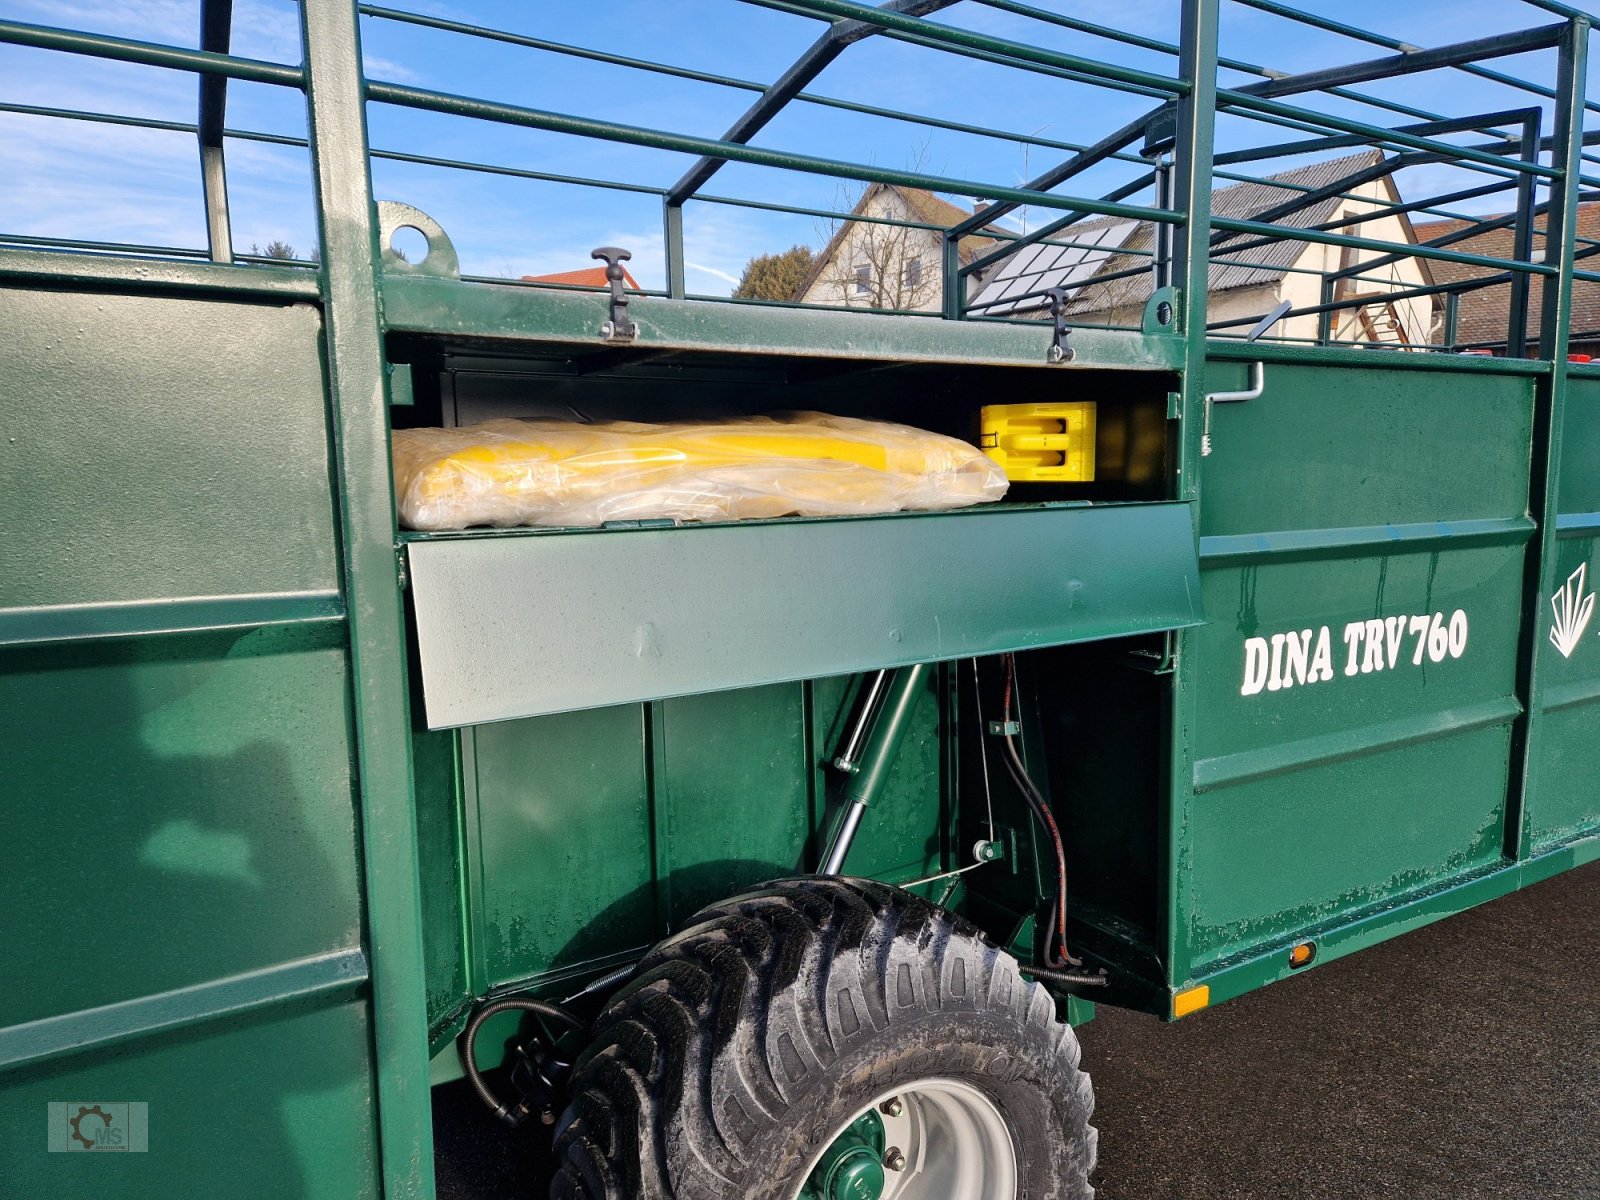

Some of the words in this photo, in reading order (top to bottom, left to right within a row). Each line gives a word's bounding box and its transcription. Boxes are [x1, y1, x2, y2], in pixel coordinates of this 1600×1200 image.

[1241, 625, 1334, 695] DINA
[1344, 615, 1407, 676] TRV
[1409, 609, 1468, 665] 760
